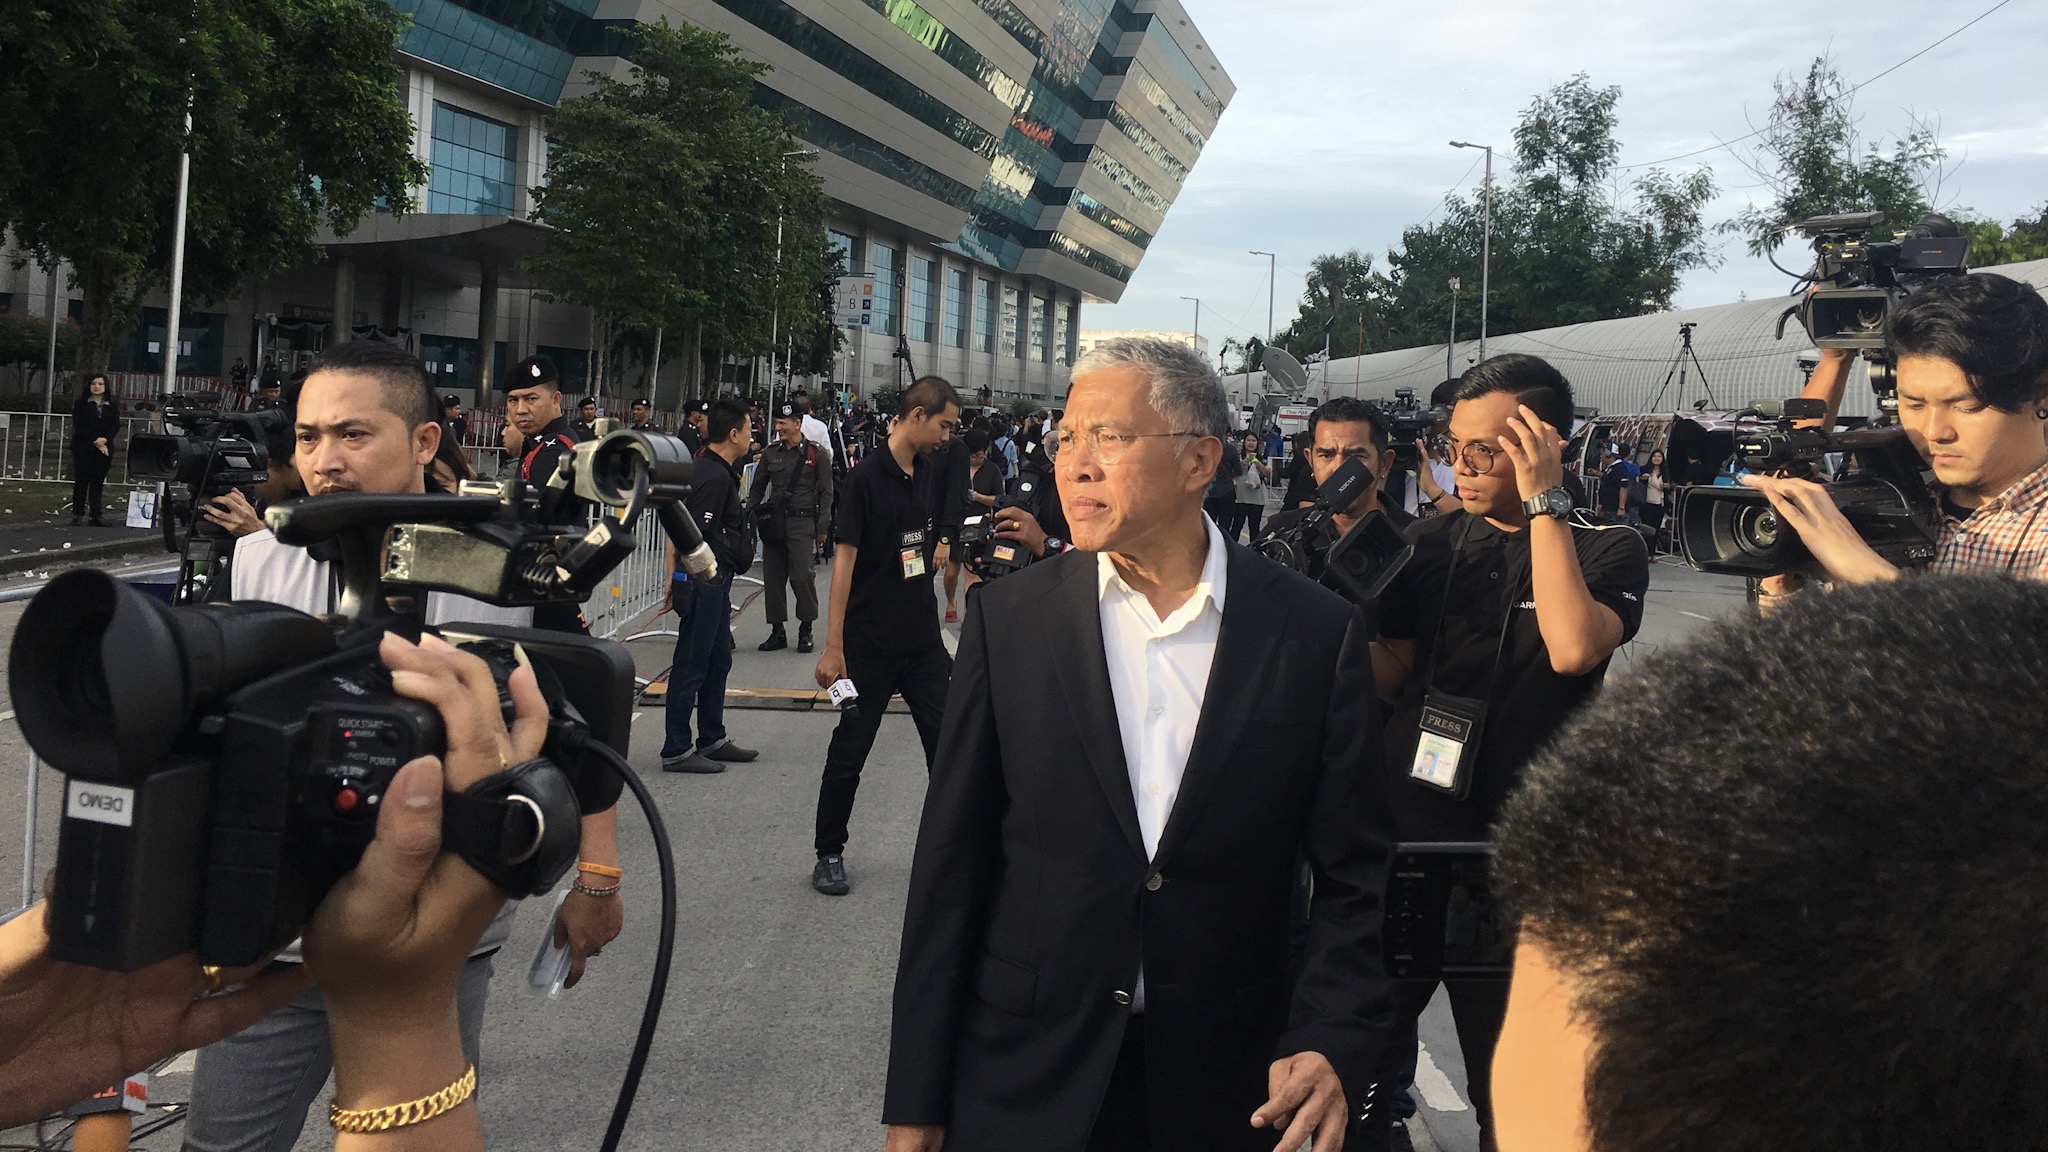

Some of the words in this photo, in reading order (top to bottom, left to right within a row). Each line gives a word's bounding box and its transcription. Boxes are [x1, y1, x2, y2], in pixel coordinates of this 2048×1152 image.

[850, 283, 858, 295] A
[849, 298, 856, 309] B
[903, 531, 923, 544] PRESS
[338, 718, 360, 728] QUICK
[360, 719, 384, 730] START
[1427, 714, 1462, 734] PRESS
[368, 756, 397, 767] POWER
[79, 791, 123, 812] DEMO
